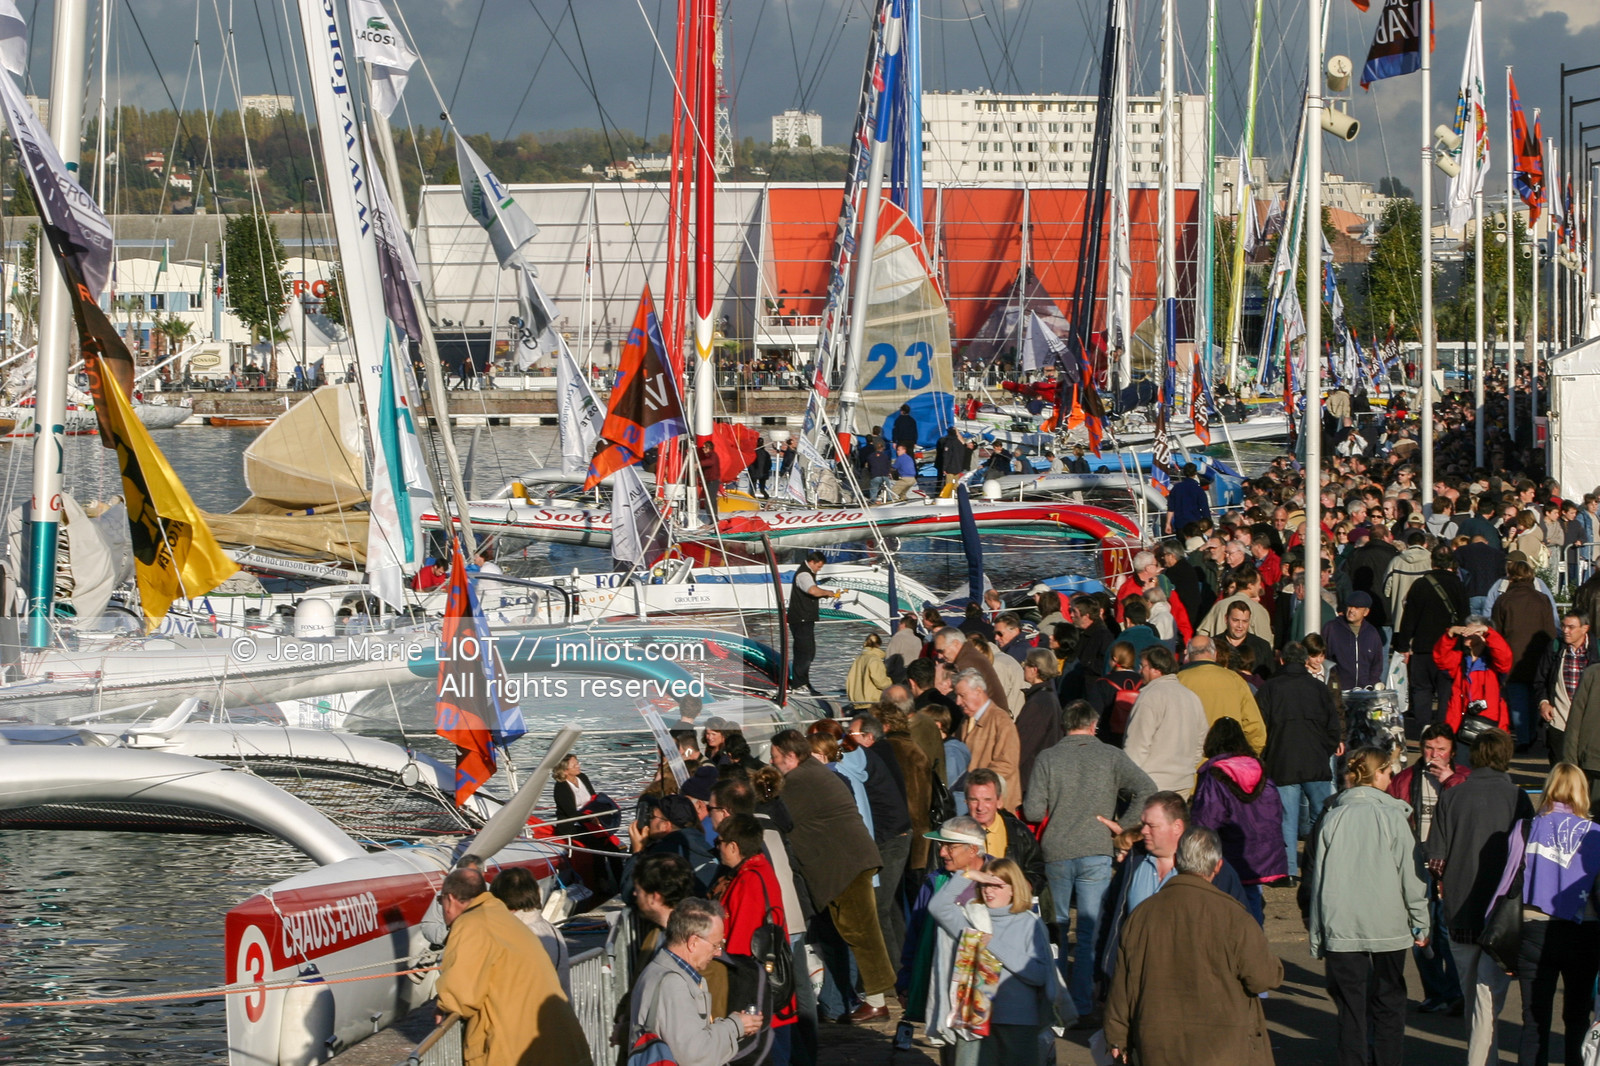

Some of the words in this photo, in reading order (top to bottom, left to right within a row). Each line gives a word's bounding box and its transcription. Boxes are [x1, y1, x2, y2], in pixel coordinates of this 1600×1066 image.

[863, 341, 934, 391] 23
[534, 509, 613, 524] Sodeb
[767, 509, 863, 526] Sodebo
[282, 891, 379, 959] CHAUSS-EUROP
[245, 942, 267, 1024] 3
